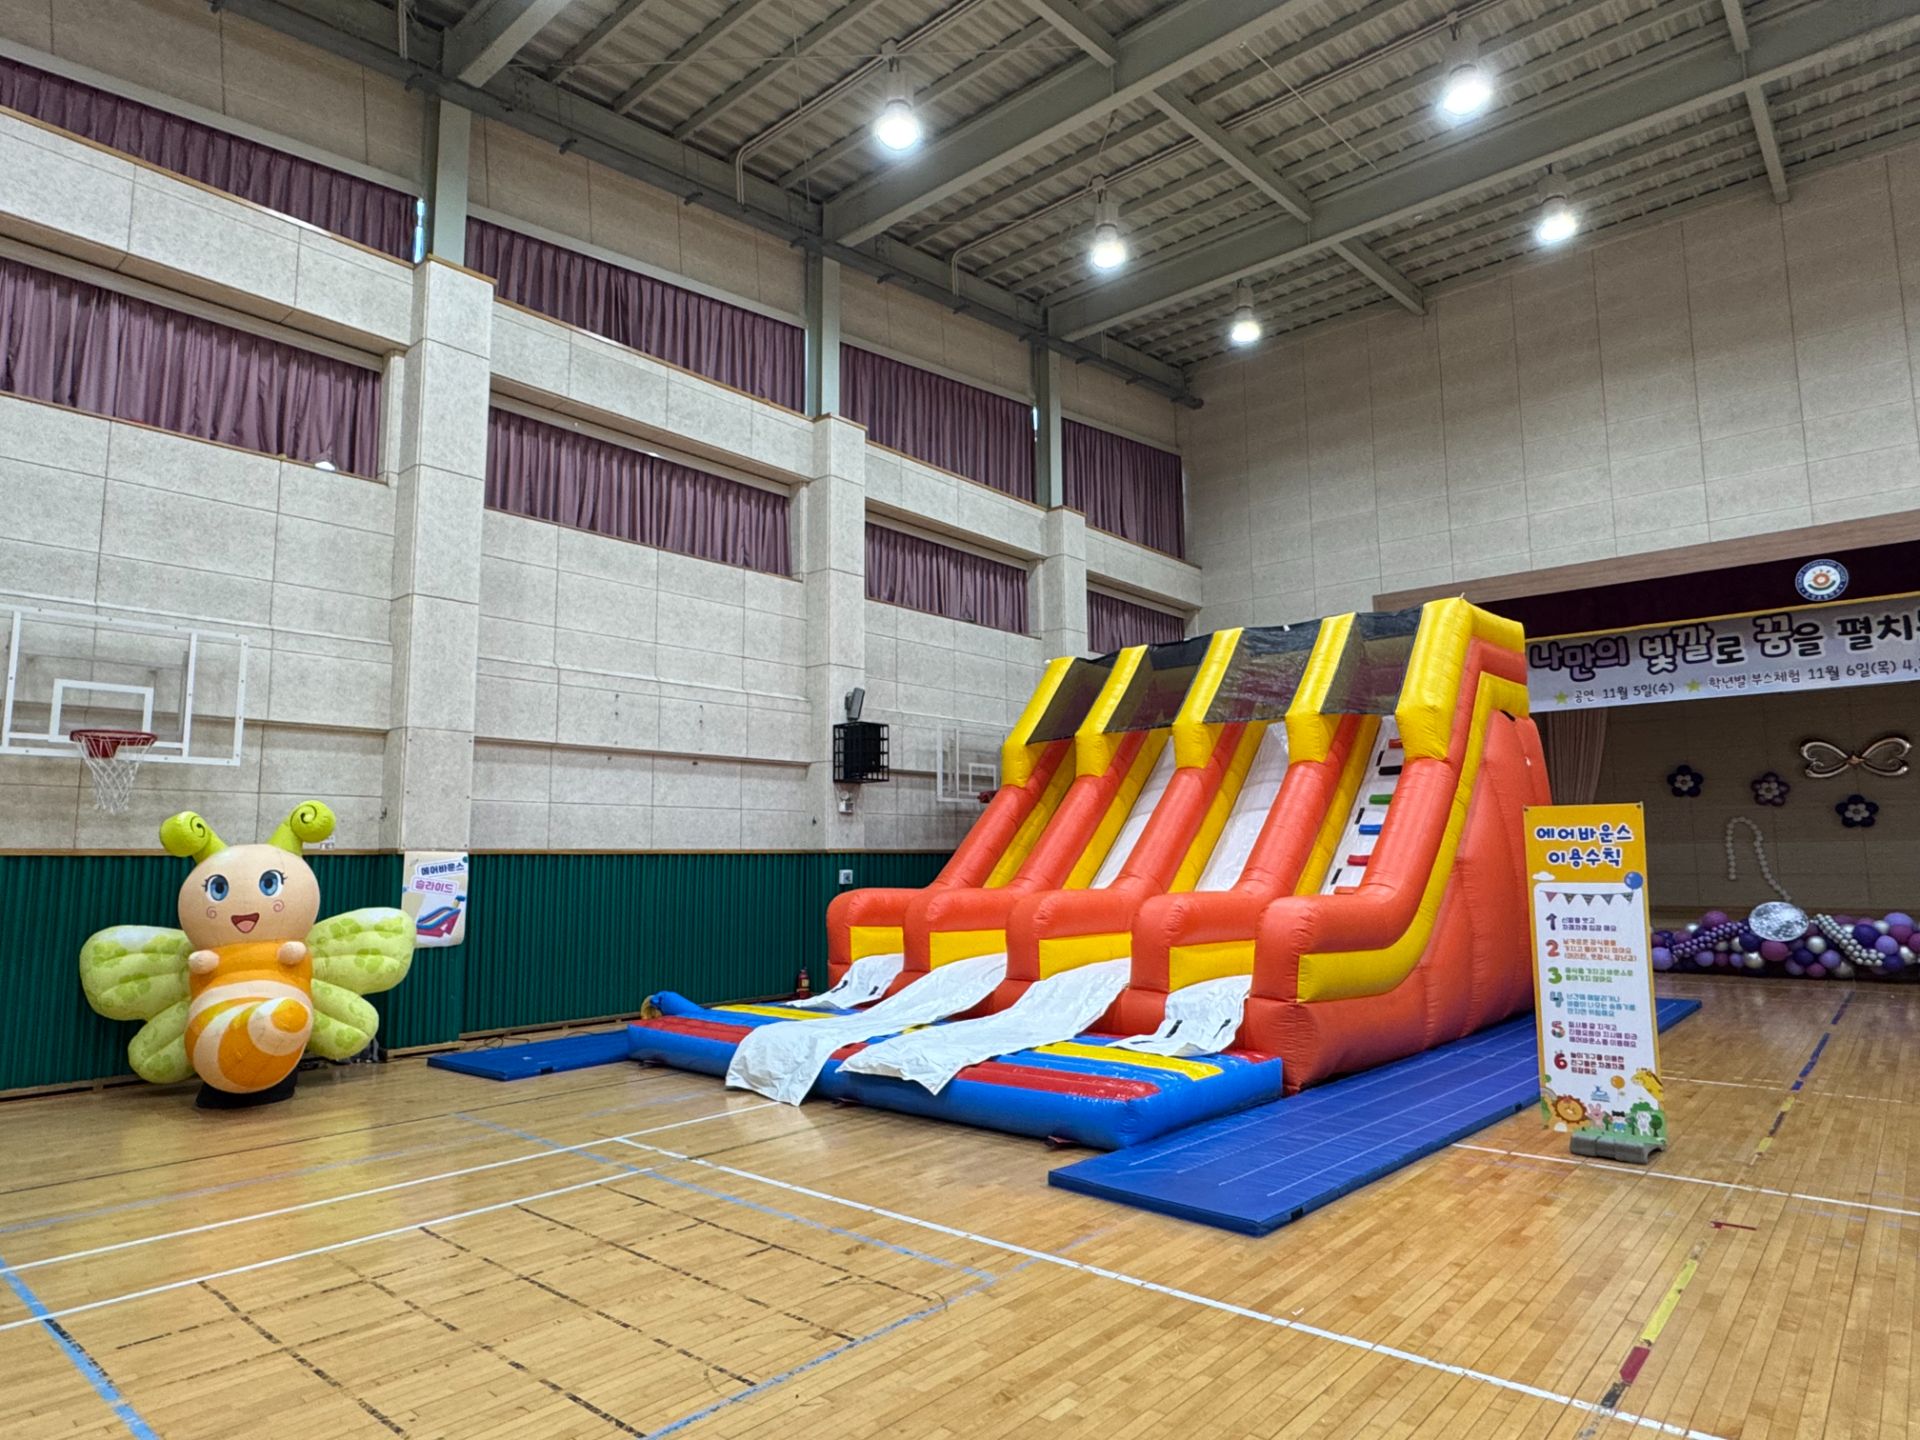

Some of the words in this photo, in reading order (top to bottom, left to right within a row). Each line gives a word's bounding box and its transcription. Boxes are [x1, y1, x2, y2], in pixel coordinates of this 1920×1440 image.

[1529, 635, 1630, 682] 나만의
[1639, 622, 1745, 675] 빛깔로
[1752, 611, 1824, 658] 꿈을
[1836, 608, 1920, 651] 펼치
[1708, 674, 1747, 690] 학년별
[1751, 669, 1801, 686] 부스체험
[1807, 664, 1840, 681] 11월
[1846, 659, 1897, 679] 6일(목)
[1902, 658, 1920, 674] 4,
[1575, 690, 1595, 704] 공연
[1602, 686, 1629, 700] 11월
[1633, 682, 1675, 698] 5일(수)
[1535, 823, 1634, 845] 에어바운스
[1547, 846, 1622, 869] 이용수칙
[420, 862, 465, 876] 에어바운스
[415, 879, 454, 893] 슬라이드
[1545, 913, 1557, 931] 1
[1545, 939, 1560, 957] 2
[1548, 966, 1562, 984] 3
[1549, 991, 1564, 1008] 4
[1551, 1020, 1566, 1038] 5
[1553, 1051, 1568, 1070] 6
